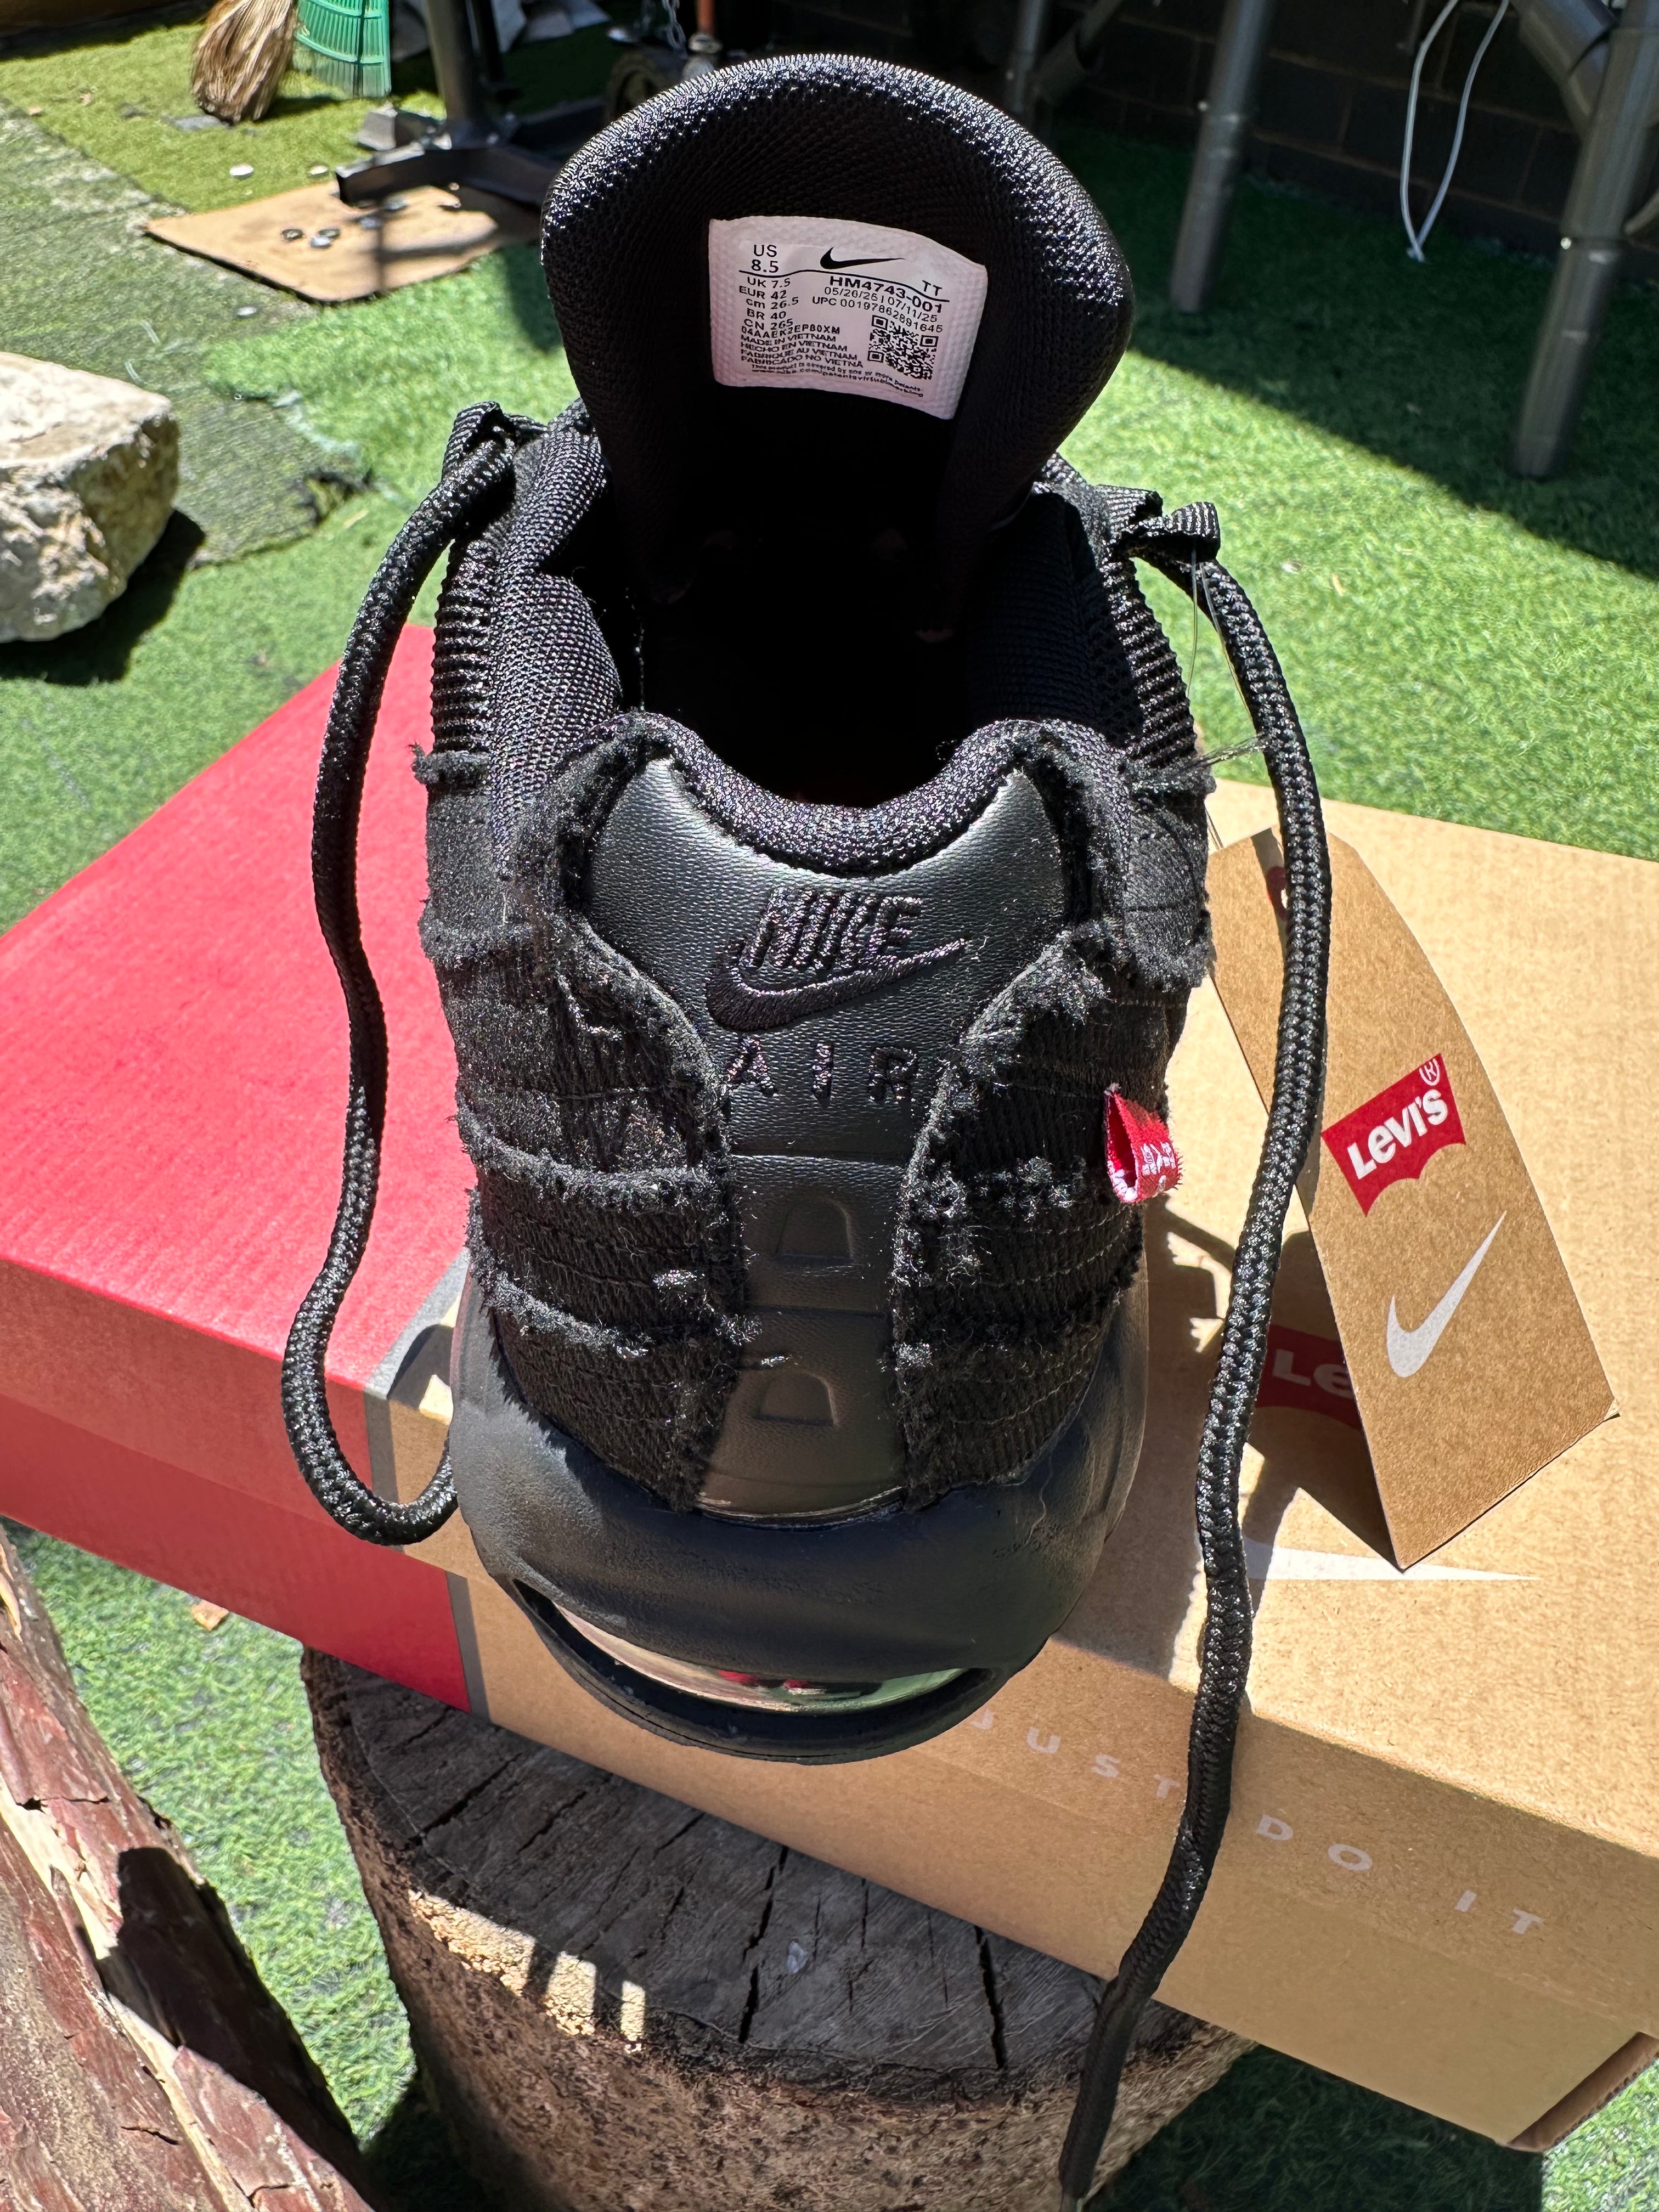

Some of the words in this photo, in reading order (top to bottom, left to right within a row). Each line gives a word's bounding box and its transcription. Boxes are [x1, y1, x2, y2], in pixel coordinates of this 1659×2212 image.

[753, 244, 777, 257] US
[751, 259, 779, 273] 8.5
[747, 276, 766, 288] UK
[771, 278, 791, 289] 7.5
[921, 279, 943, 296] TT
[739, 285, 765, 300] EUR
[770, 290, 787, 300] 42
[830, 275, 942, 313] HM4743-001
[746, 298, 765, 309] cm
[770, 296, 799, 309] 26.5
[812, 296, 837, 306] UPC
[747, 307, 765, 320] BR
[770, 311, 787, 320] 40
[743, 318, 764, 331] CN
[770, 318, 794, 330] 265
[741, 335, 772, 346] MADE
[787, 333, 836, 342] VIETNAM
[798, 340, 848, 352] VIETNAM
[812, 348, 857, 360] VIETNAM
[729, 887, 922, 969] NIKE
[723, 1039, 916, 1105] AIR
[1346, 1088, 1448, 1180] Levi's
[970, 1709, 1181, 1799] JUST
[1256, 1814, 1373, 1871] DO
[1454, 1889, 1544, 1934] IT
